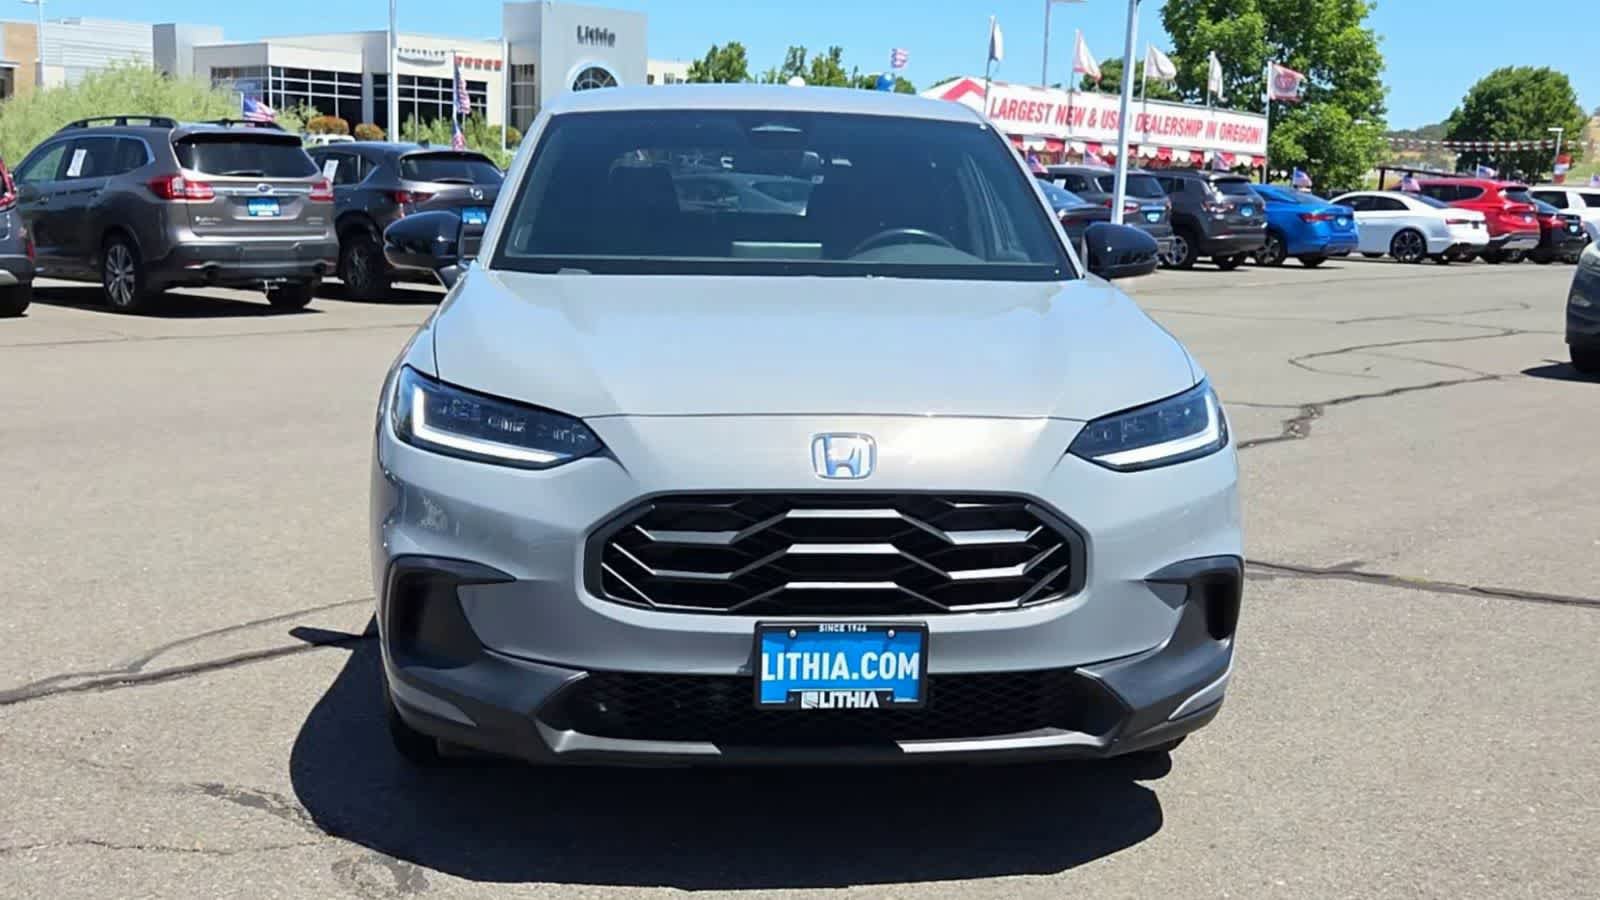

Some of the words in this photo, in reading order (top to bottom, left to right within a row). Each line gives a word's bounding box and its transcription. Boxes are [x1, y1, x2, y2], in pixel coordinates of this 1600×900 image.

[577, 25, 616, 48] Lithia
[989, 96, 1054, 124] LARGEST
[1055, 104, 1087, 126] NEW
[1087, 107, 1098, 128] &
[1135, 113, 1204, 139] DEALERSHIP
[1205, 120, 1218, 140] IN
[1220, 121, 1263, 144] OREGON!
[819, 623, 845, 633] SINCE
[761, 652, 920, 681] LITHIA.COM
[820, 690, 880, 709] LITHIA
